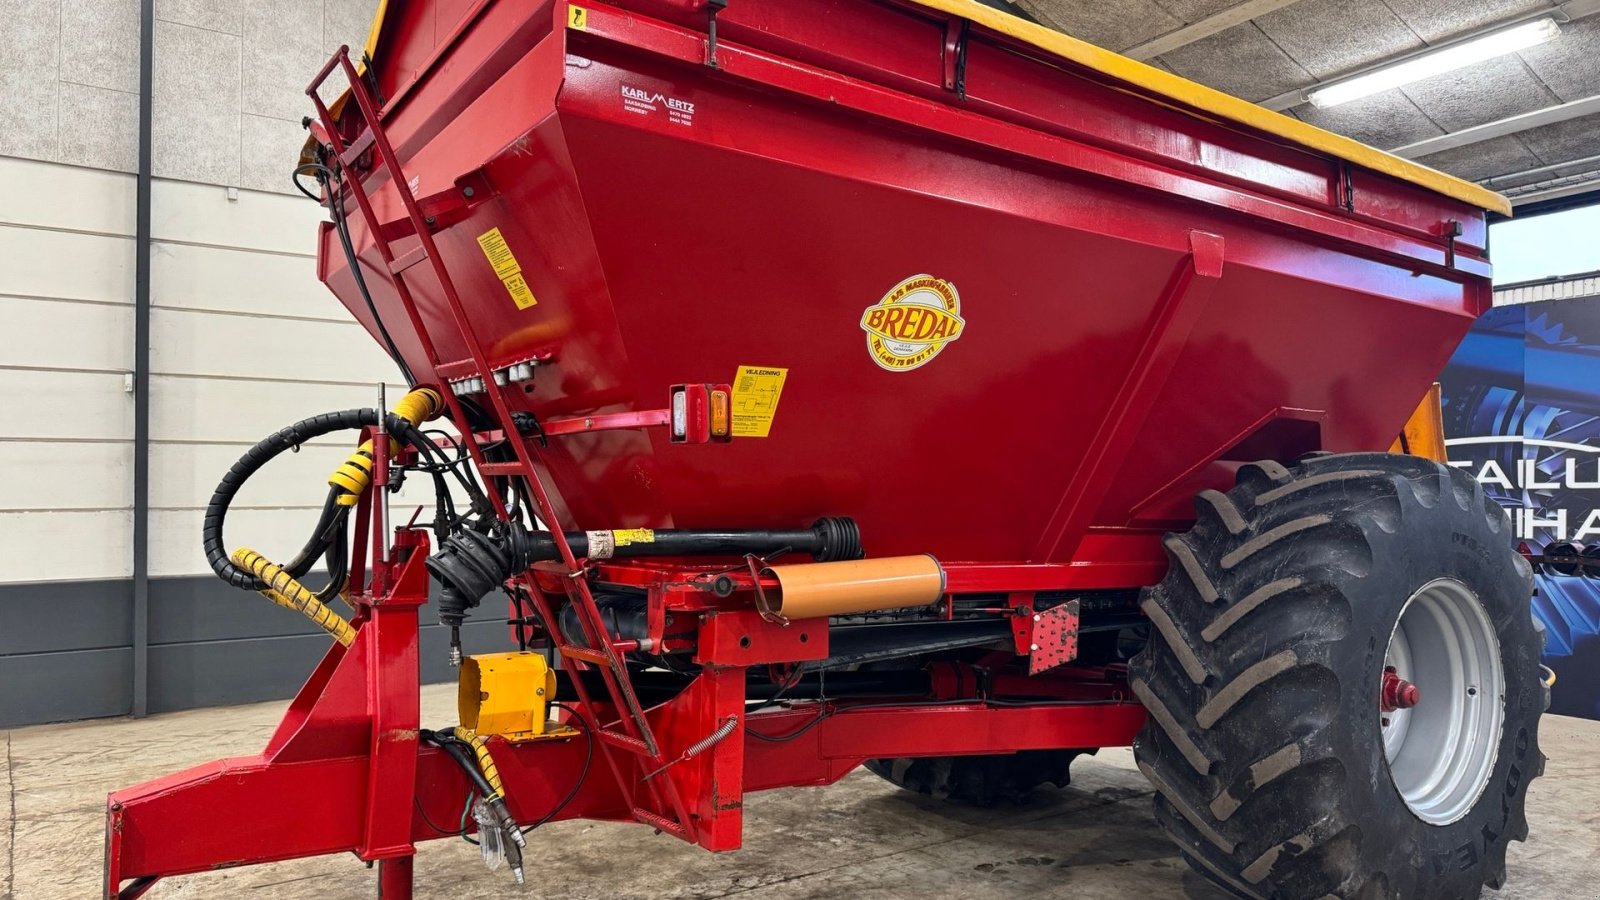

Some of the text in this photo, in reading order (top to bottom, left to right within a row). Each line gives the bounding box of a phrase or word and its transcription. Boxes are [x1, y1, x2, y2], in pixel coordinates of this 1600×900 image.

[621, 85, 650, 101] KARL
[890, 288, 904, 302] A/S
[867, 307, 959, 341] BREDAL
[1505, 508, 1600, 540] IHA
